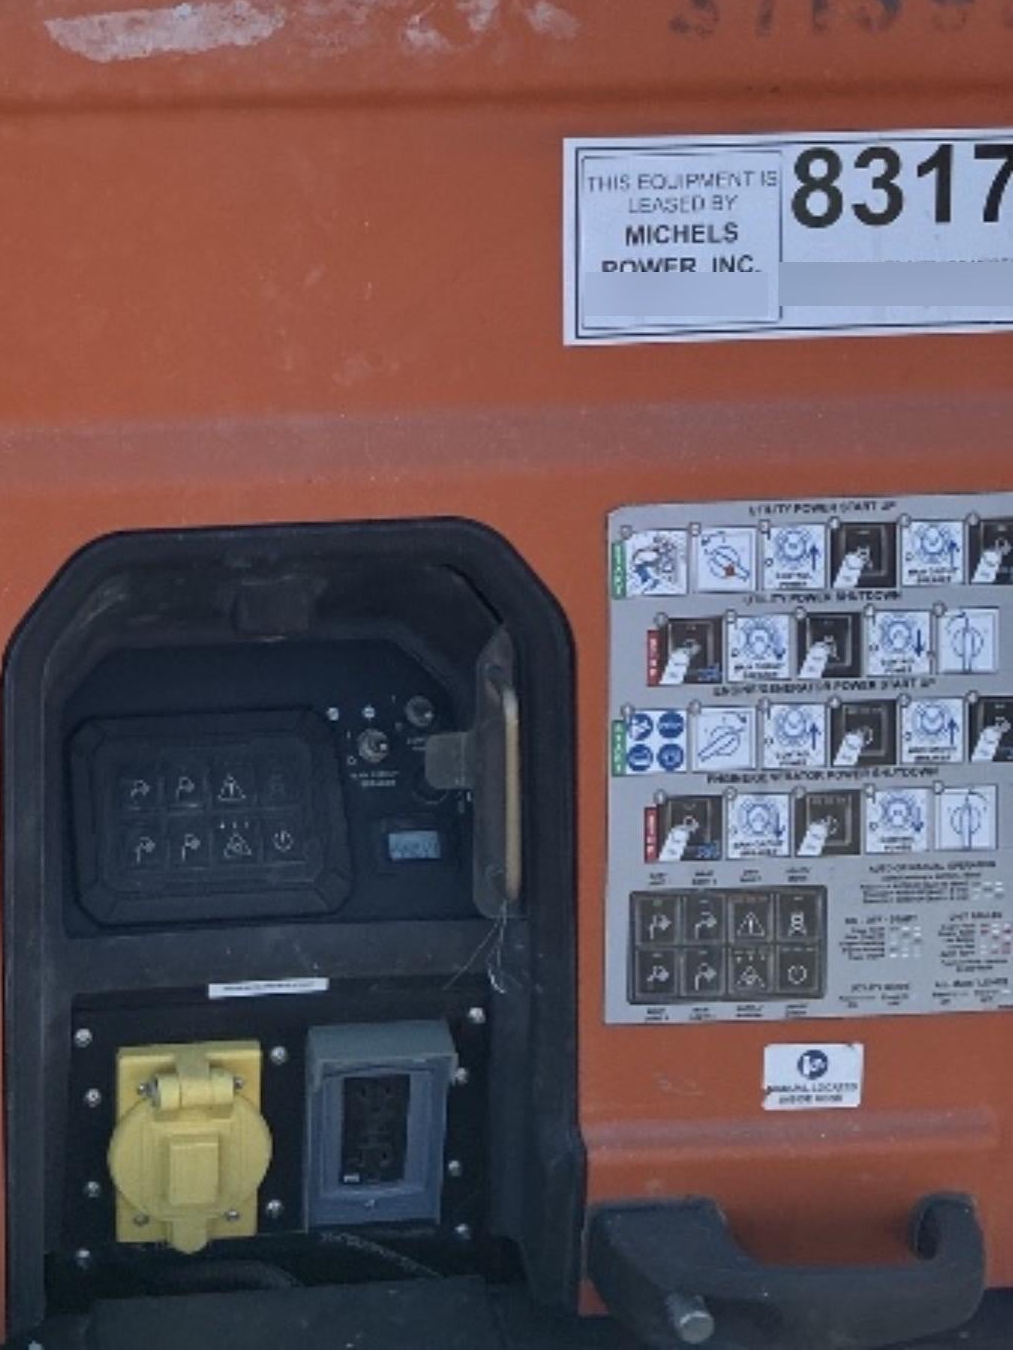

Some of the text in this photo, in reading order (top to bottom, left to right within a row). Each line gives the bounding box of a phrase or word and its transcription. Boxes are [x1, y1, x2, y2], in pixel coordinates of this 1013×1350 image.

[587, 173, 631, 193] THIS
[637, 170, 755, 191] EQUIPMENT
[627, 193, 739, 214] LEASED BY
[625, 222, 739, 247] MICHELS
